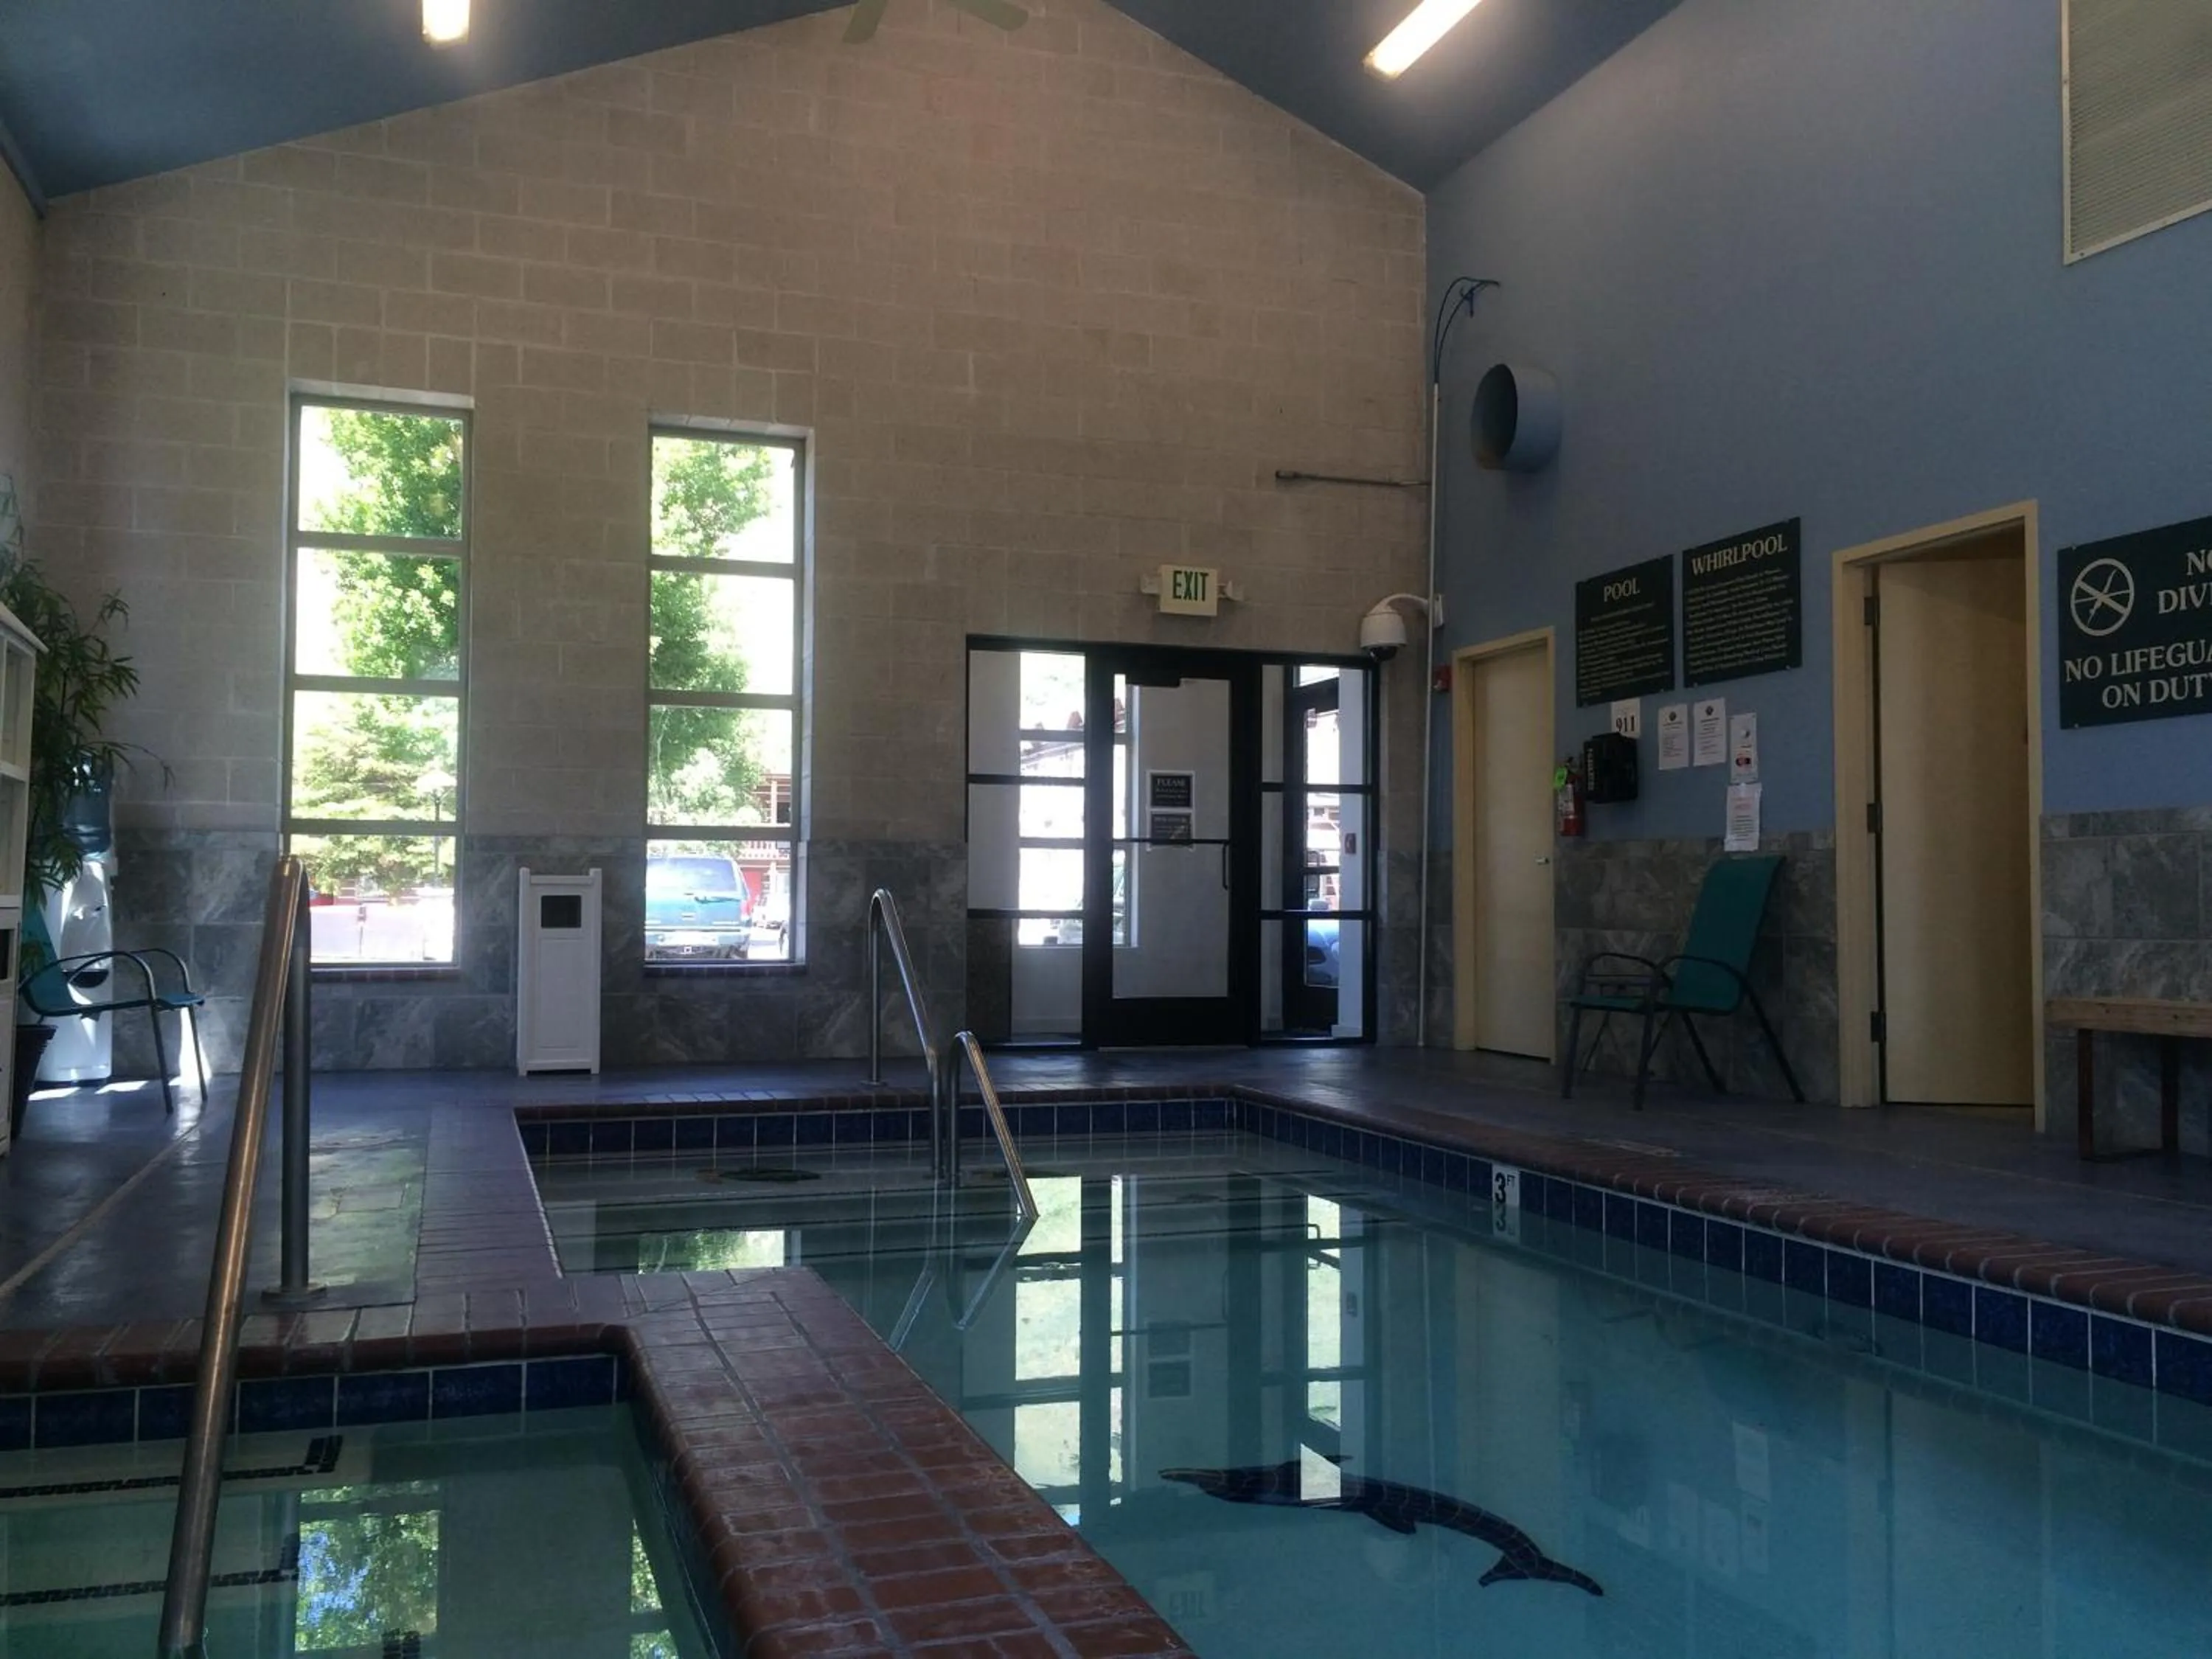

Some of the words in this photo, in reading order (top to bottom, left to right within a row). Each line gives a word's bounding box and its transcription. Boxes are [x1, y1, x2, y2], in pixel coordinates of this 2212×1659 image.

[1691, 534, 1788, 576] WHIRLPOOL
[2185, 549, 2212, 576] N
[1173, 570, 1209, 601] EXIT
[1603, 577, 1641, 602] POOL
[2065, 655, 2102, 683] NO
[2111, 639, 2212, 676] LIFEGU
[2102, 681, 2140, 708] ON
[2149, 672, 2212, 703] DUT
[1615, 714, 1635, 732] 911
[1495, 1172, 1506, 1204] 3
[1507, 1174, 1515, 1188] FT
